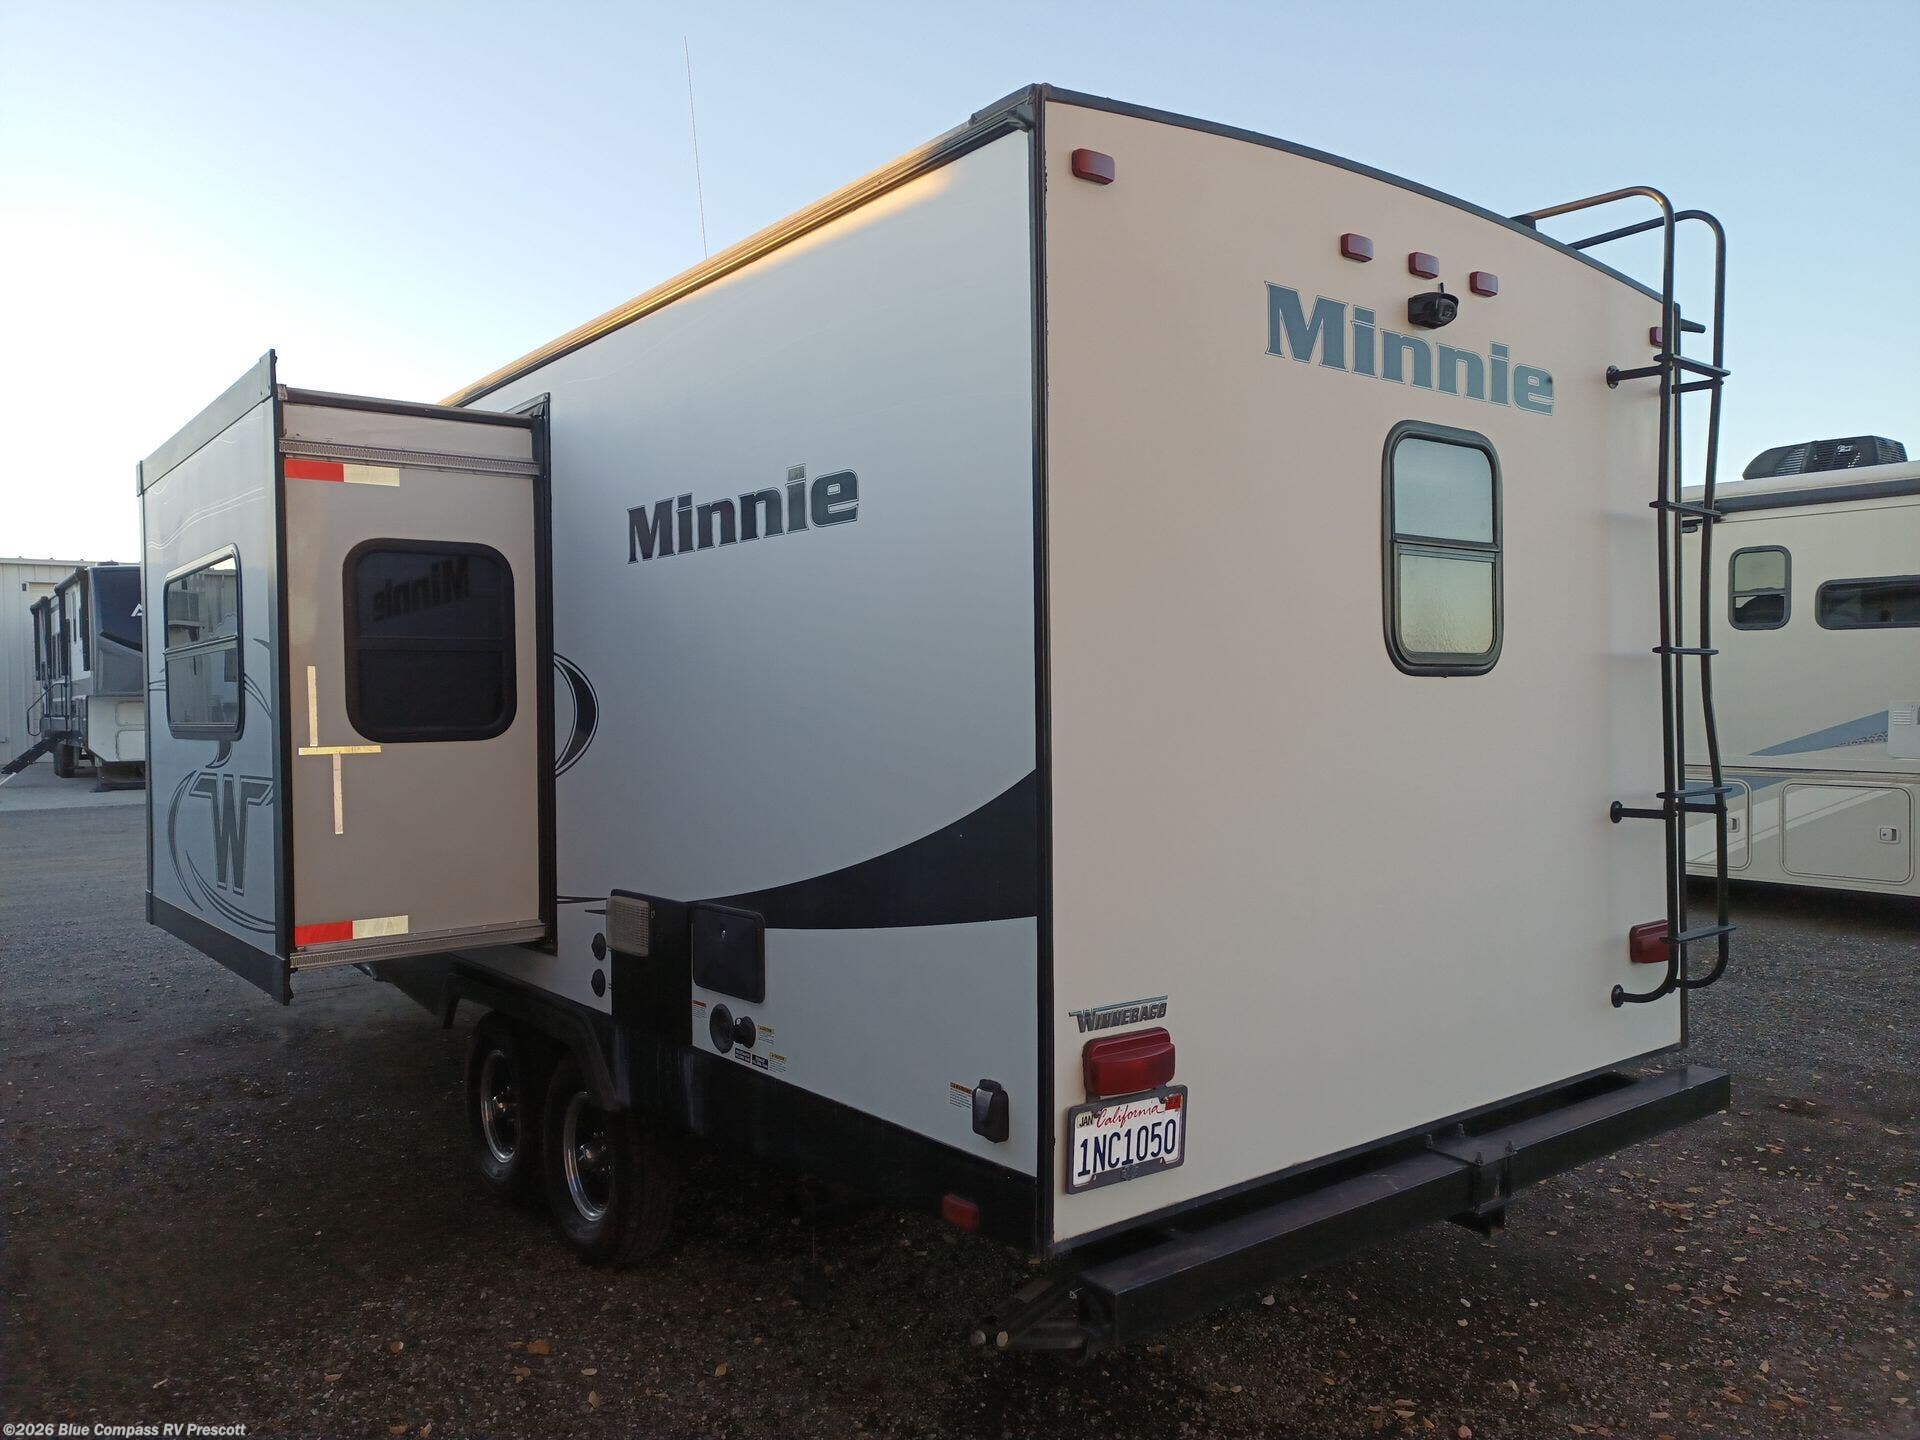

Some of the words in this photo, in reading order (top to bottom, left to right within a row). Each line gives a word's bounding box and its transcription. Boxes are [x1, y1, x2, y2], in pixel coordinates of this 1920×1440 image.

[1264, 280, 1554, 416] Minnie
[627, 463, 859, 564] Minnie
[1078, 1118, 1176, 1177] 1NC1050
[1079, 1114, 1093, 1127] JAN
[1096, 1103, 1164, 1128] California
